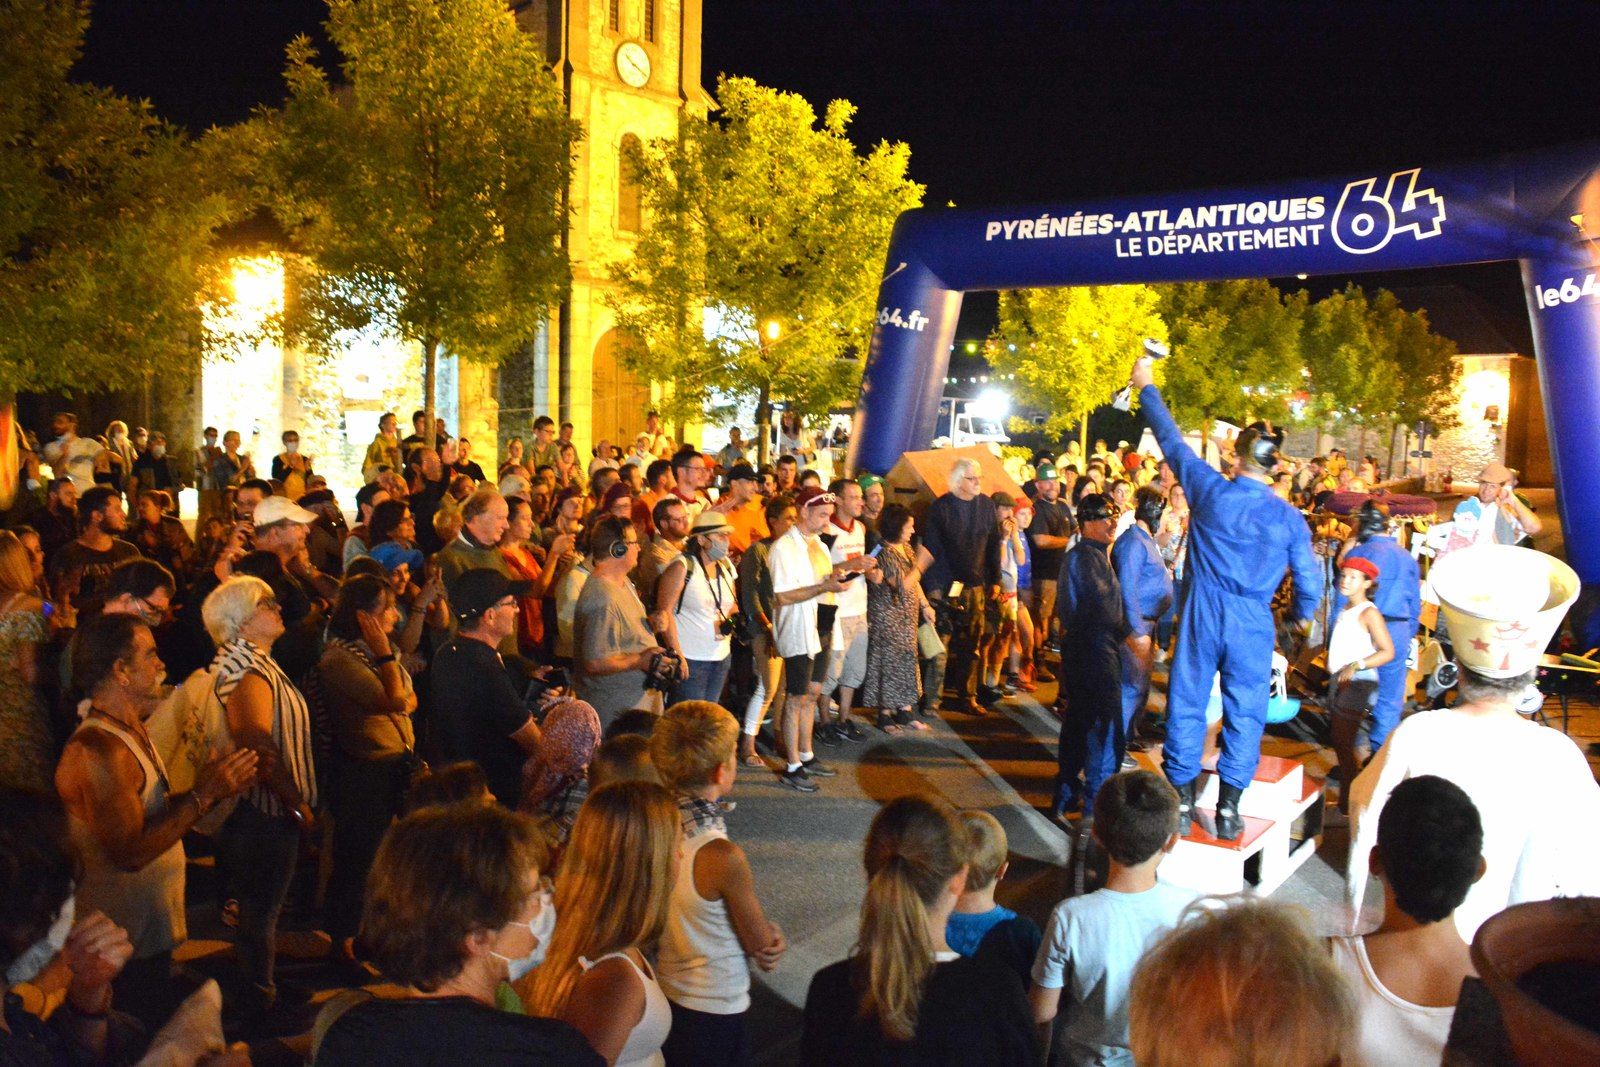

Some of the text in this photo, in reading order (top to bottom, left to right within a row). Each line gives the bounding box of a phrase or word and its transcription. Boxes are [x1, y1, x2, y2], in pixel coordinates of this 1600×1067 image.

[985, 196, 1326, 242] PYRÉNÉES-ATLANTIQUES
[1331, 167, 1447, 255] 64
[1115, 224, 1325, 258] LE DÉPARTEMENT
[1535, 273, 1600, 310] le64
